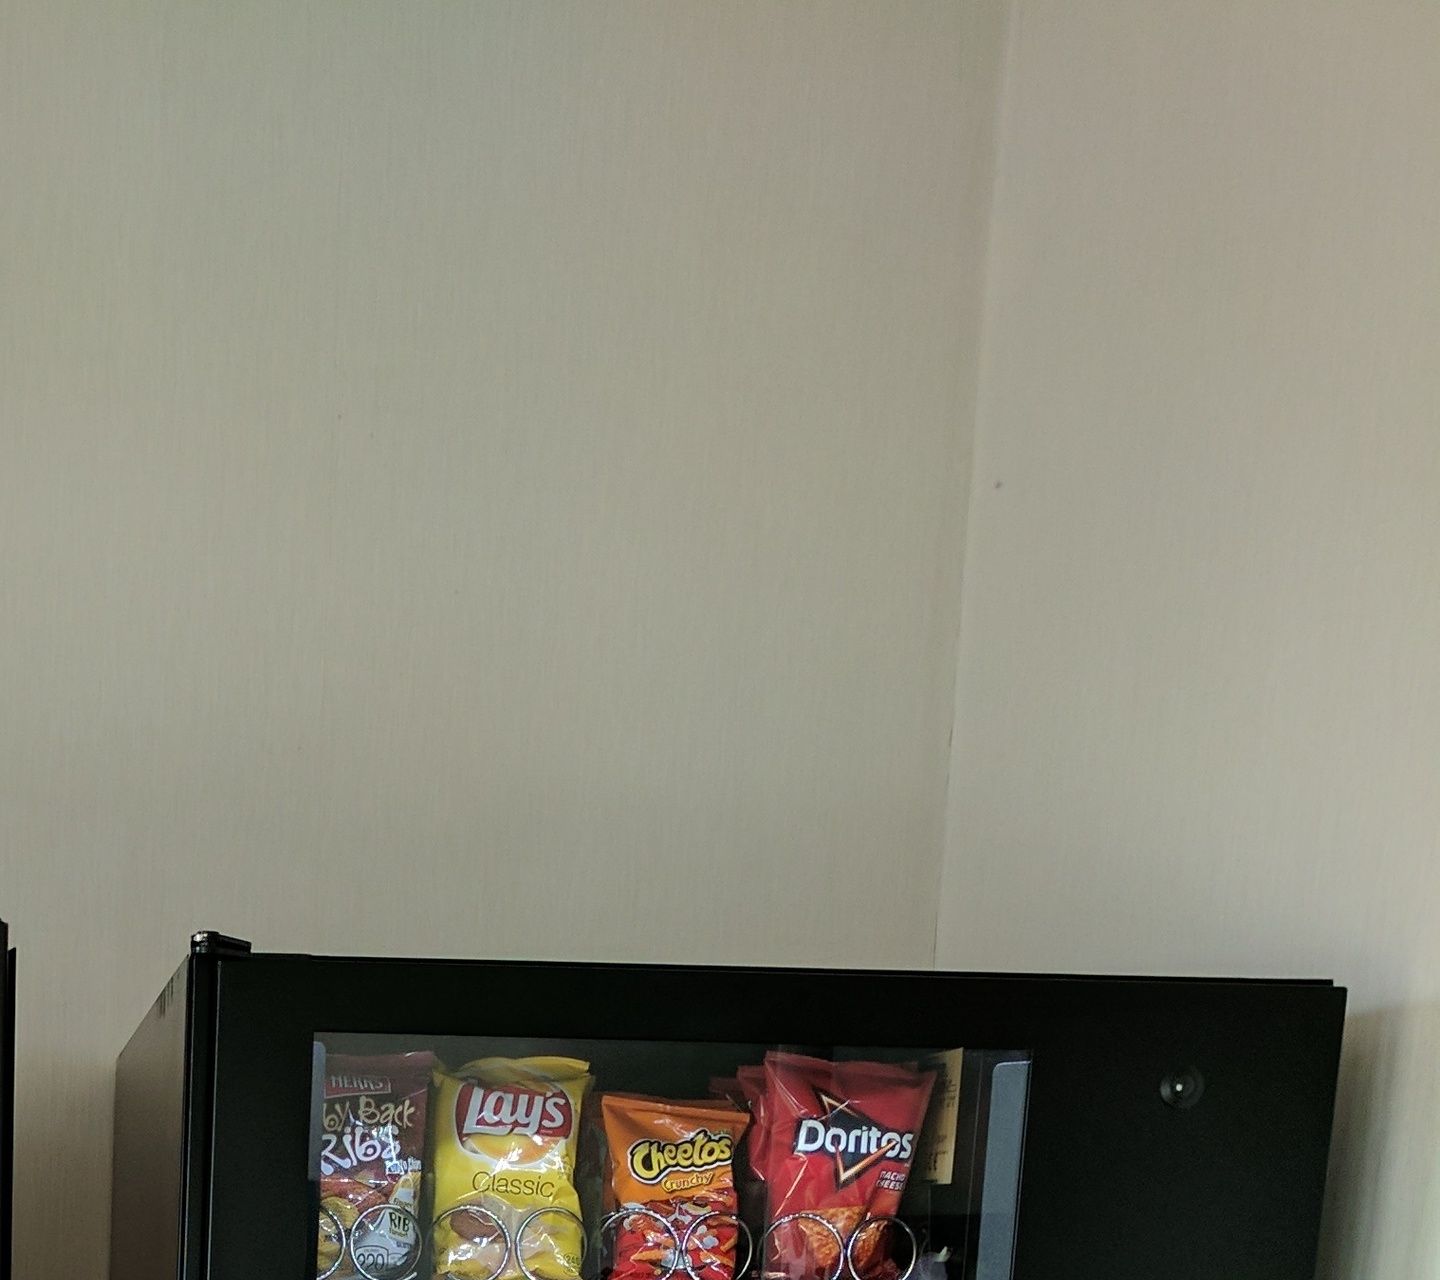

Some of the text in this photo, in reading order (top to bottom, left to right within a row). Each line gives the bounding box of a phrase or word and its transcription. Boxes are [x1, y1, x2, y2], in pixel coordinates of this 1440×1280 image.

[360, 1096, 415, 1127] Back
[463, 1088, 567, 1136] Lay's
[798, 1119, 913, 1159] Doritos
[631, 1134, 732, 1177] Cheetos
[472, 1171, 555, 1198] Classic
[662, 1172, 713, 1191] Crunchy
[388, 1212, 410, 1232] RIB
